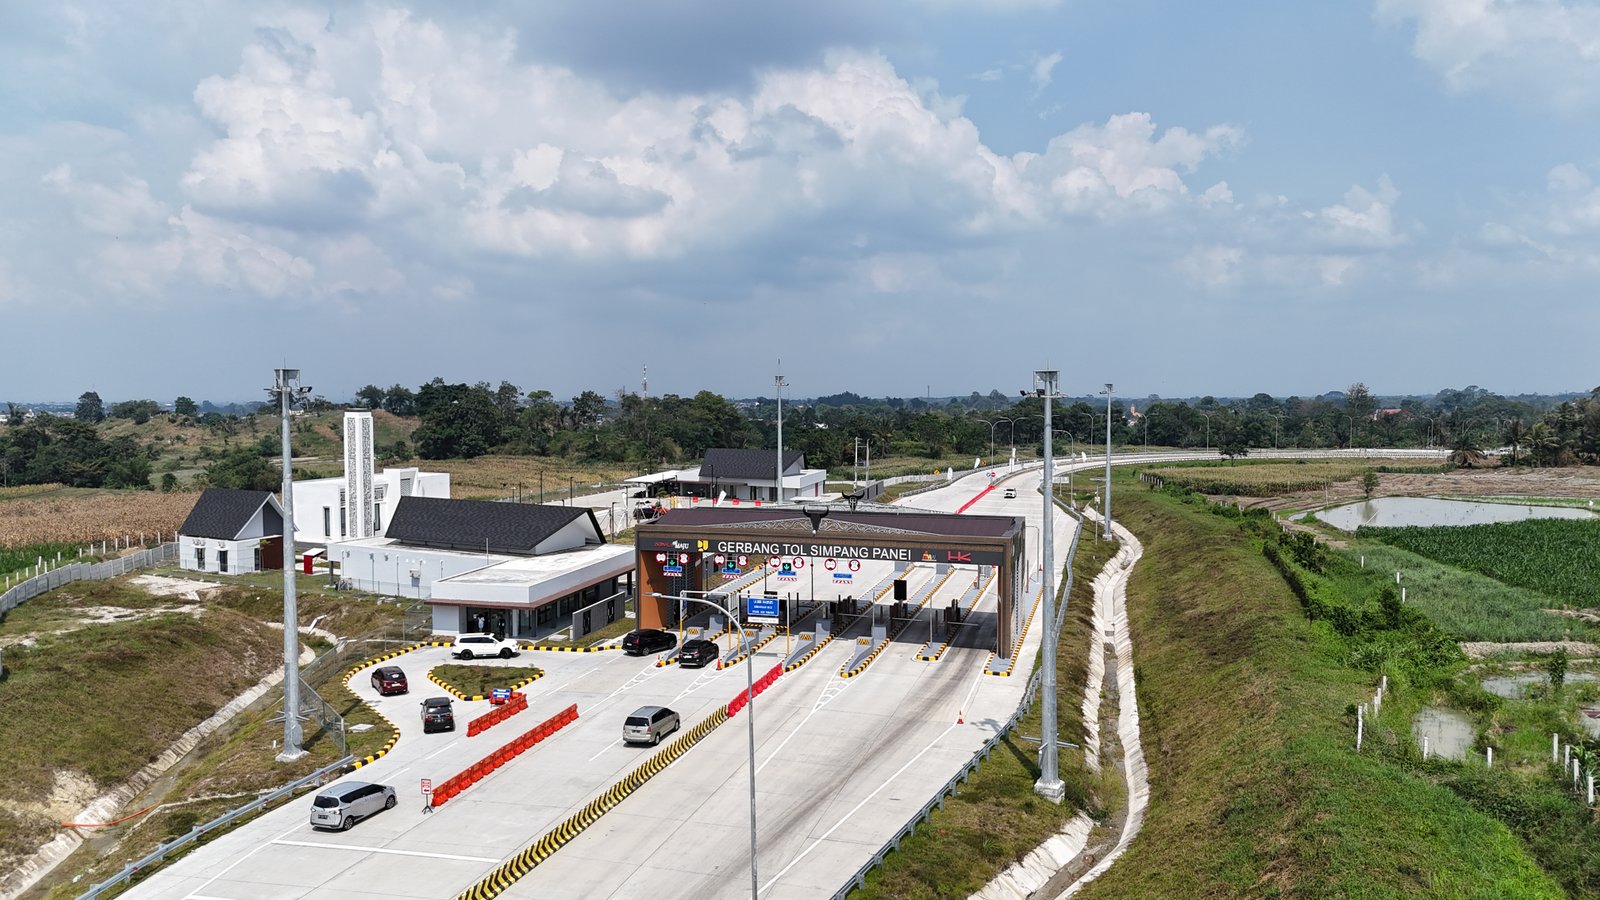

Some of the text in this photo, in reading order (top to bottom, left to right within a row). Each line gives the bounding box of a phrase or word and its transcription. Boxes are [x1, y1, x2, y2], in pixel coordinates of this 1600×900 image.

[718, 541, 780, 555] GERBANG
[783, 544, 807, 556] TOL
[810, 545, 869, 558] SIMPANG
[872, 548, 911, 560] PANEI
[947, 551, 972, 562] HK
